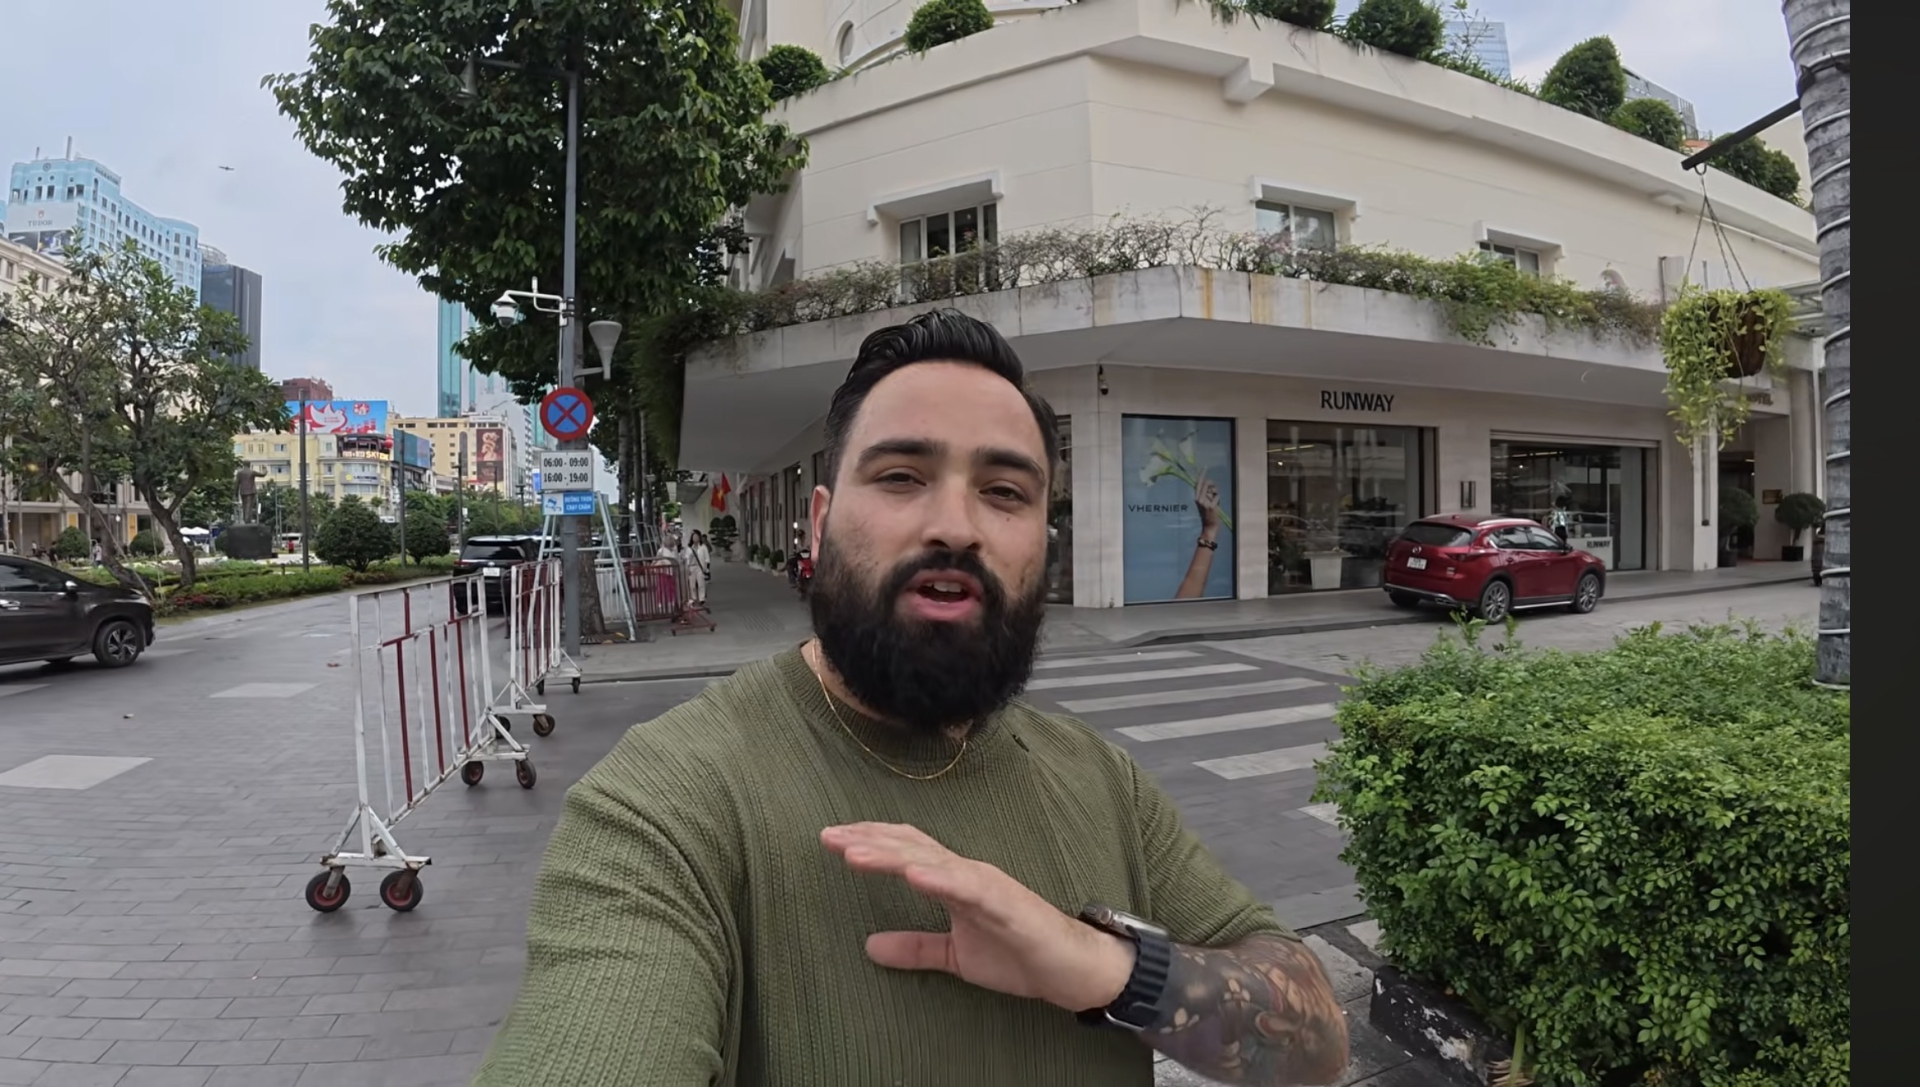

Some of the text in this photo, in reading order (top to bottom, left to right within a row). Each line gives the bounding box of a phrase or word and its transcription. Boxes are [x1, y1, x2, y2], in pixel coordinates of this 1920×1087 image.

[1321, 391, 1394, 412] RUNWAY
[544, 458, 563, 467] 06:00
[569, 457, 588, 467] 09:00
[544, 473, 563, 482] 16:00
[569, 473, 588, 482] 19:00
[1128, 504, 1188, 512] VHERNIER
[1586, 541, 1611, 549] RUNWAY
